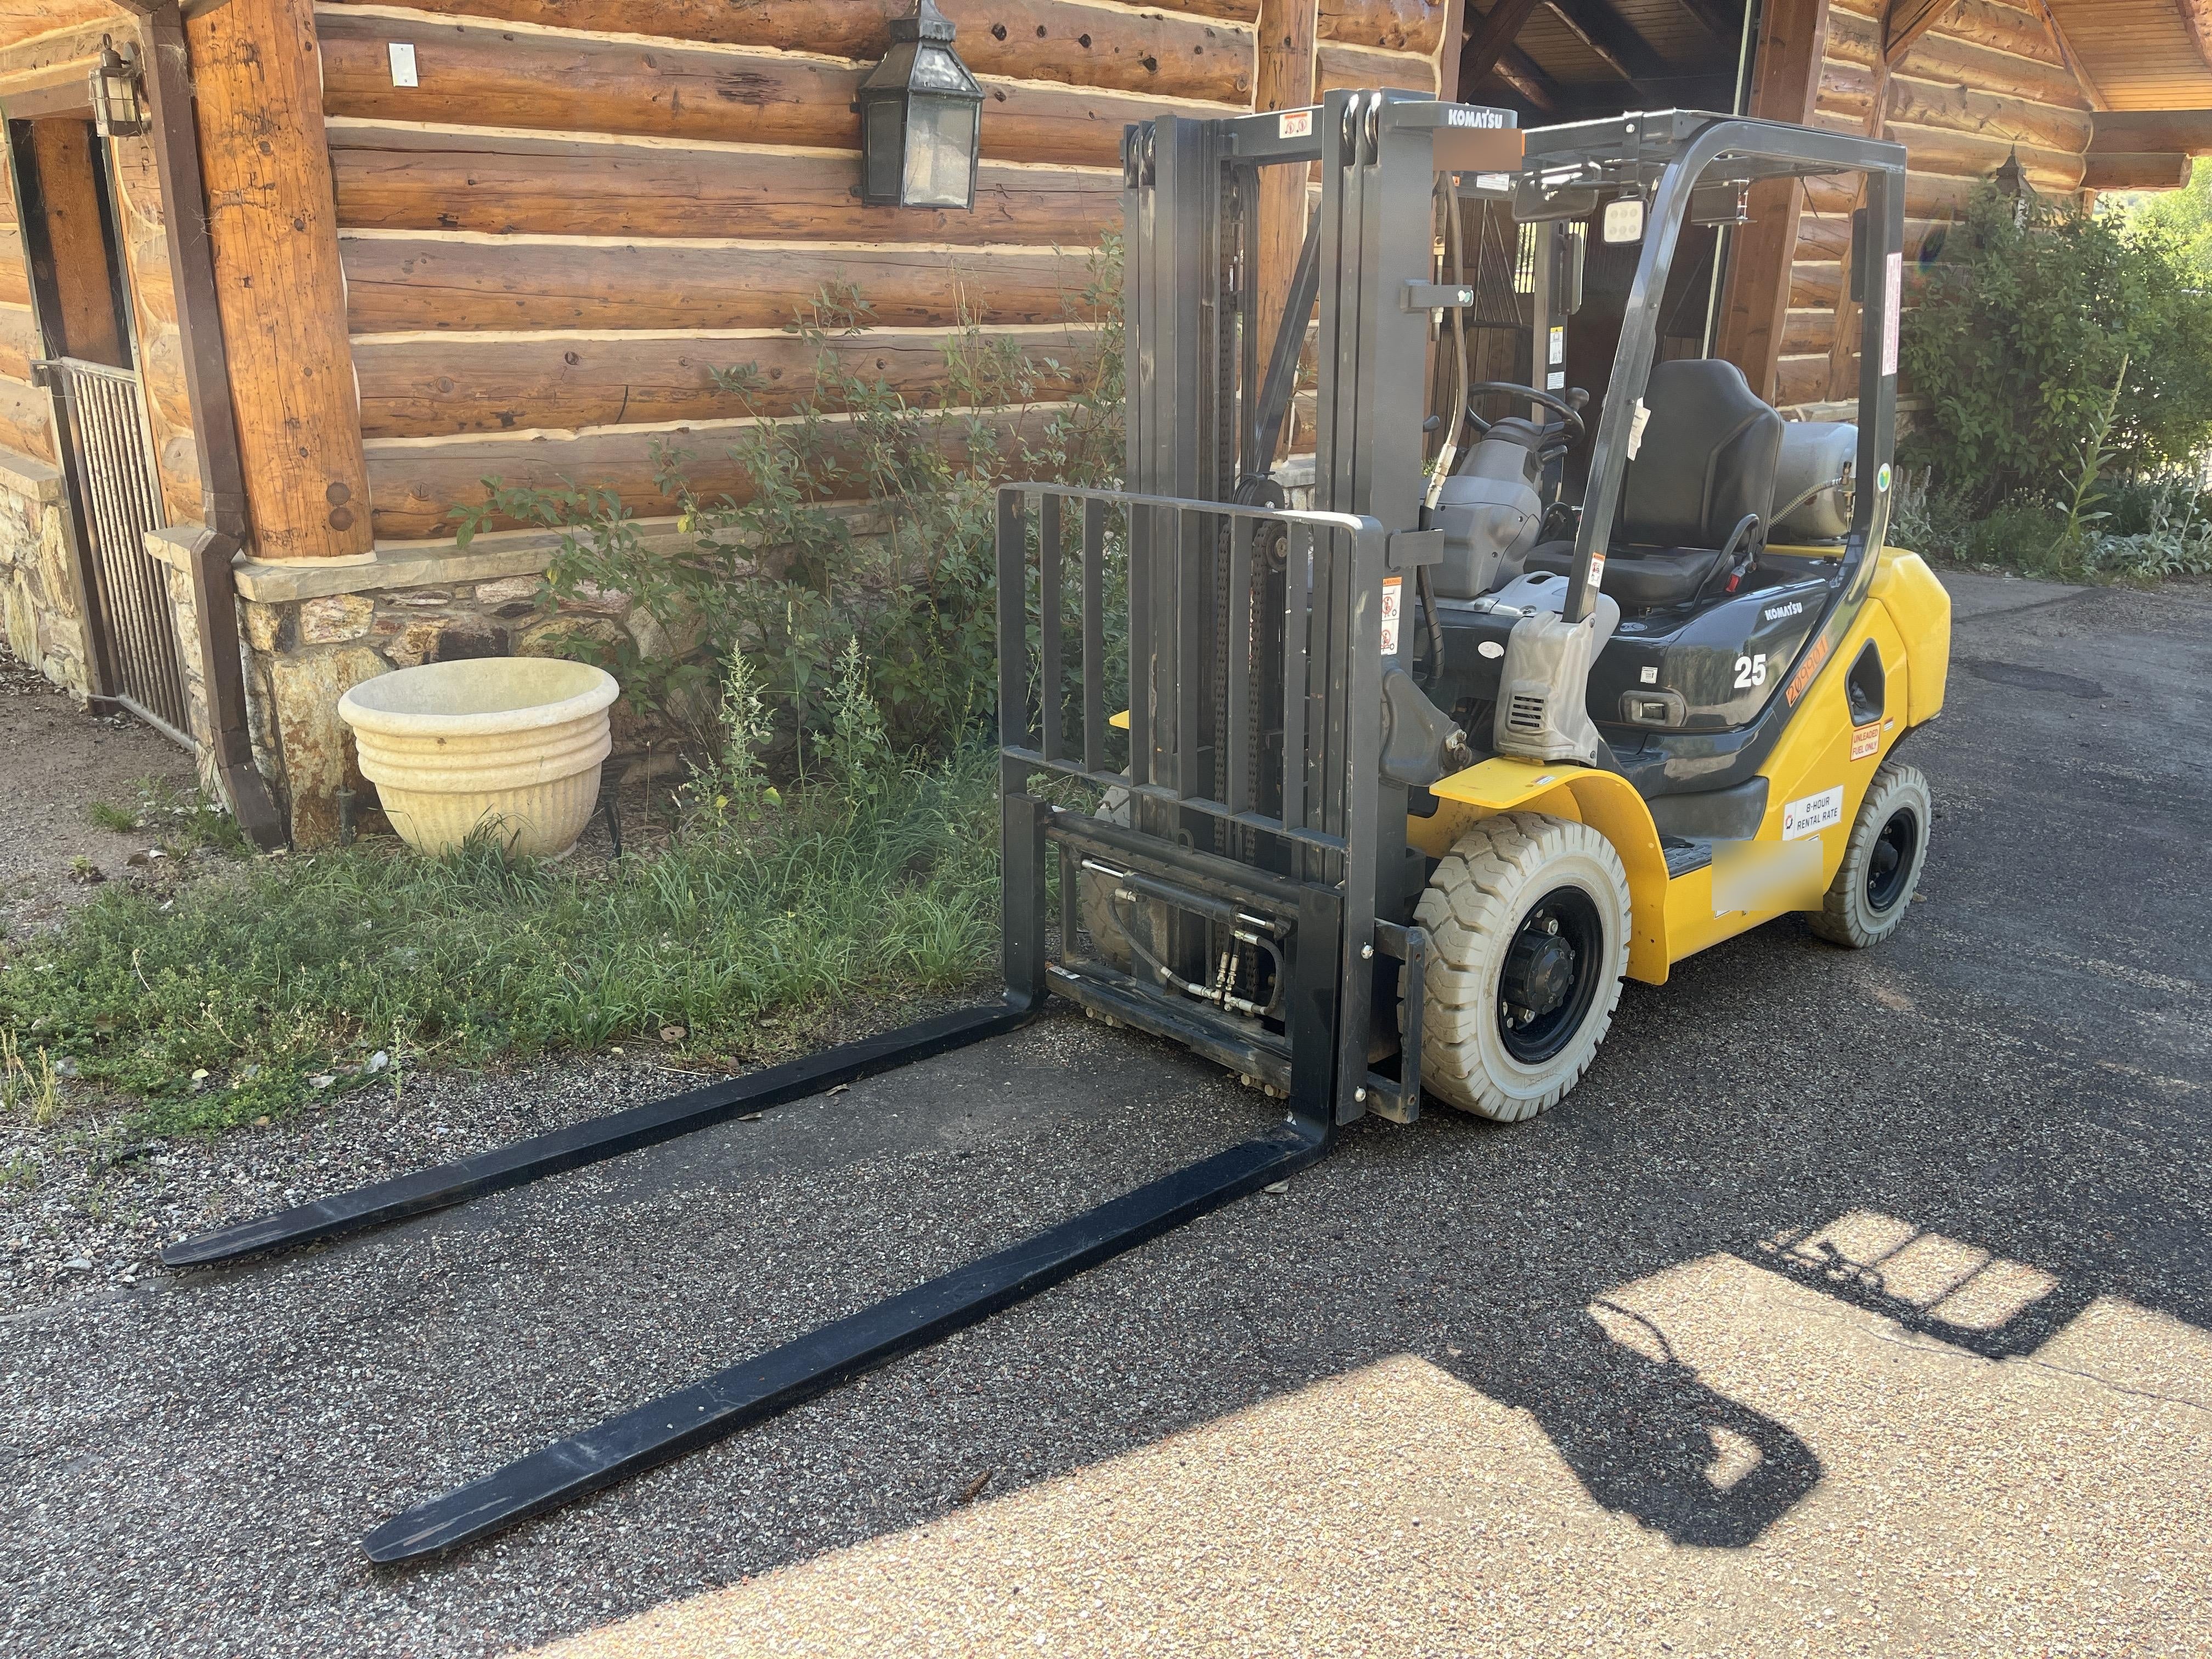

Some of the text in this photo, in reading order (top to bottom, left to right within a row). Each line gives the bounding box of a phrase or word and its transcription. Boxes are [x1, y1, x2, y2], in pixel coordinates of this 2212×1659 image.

[1448, 109, 1503, 129] KOMATSU
[1764, 601, 1803, 621] KOMATSU
[1734, 653, 1767, 689] 25
[1853, 729, 1878, 743] UNLEADED
[1852, 741, 1877, 755] FUEL ONLY
[1806, 797, 1830, 812] 8-HOUR
[1797, 807, 1838, 831] RENTAL RATE
